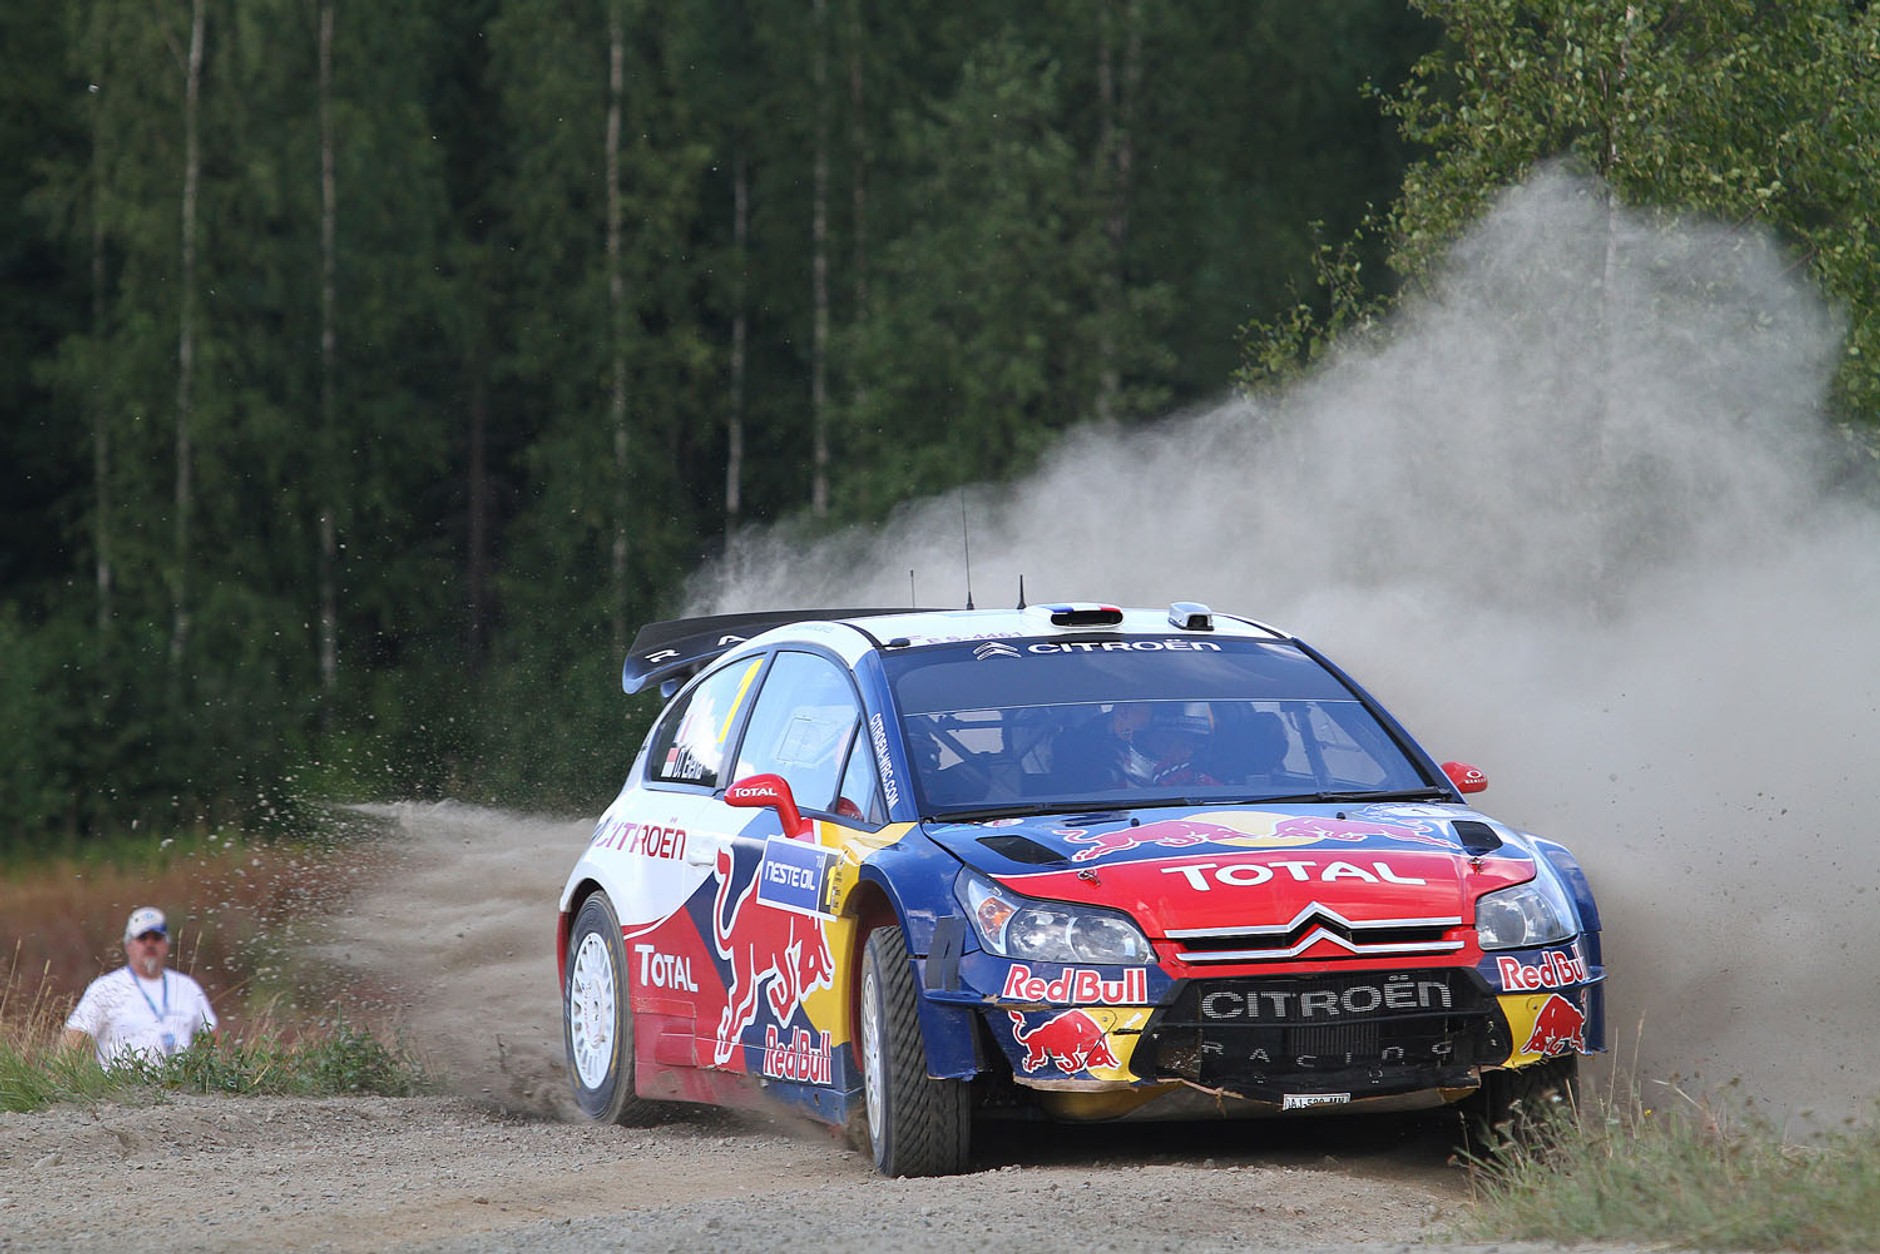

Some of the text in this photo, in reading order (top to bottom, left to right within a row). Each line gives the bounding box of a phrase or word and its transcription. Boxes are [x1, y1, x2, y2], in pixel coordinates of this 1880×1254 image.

[1028, 639, 1221, 655] CITROËN
[733, 786, 778, 797] TOTAL
[1160, 860, 1427, 891] TOTAL
[634, 944, 698, 992] TOTAL
[1002, 963, 1148, 1004] Red Bull
[1496, 951, 1559, 991] Red
[1200, 974, 1453, 1019] CITROËN
[763, 1024, 833, 1085] Red Bull
